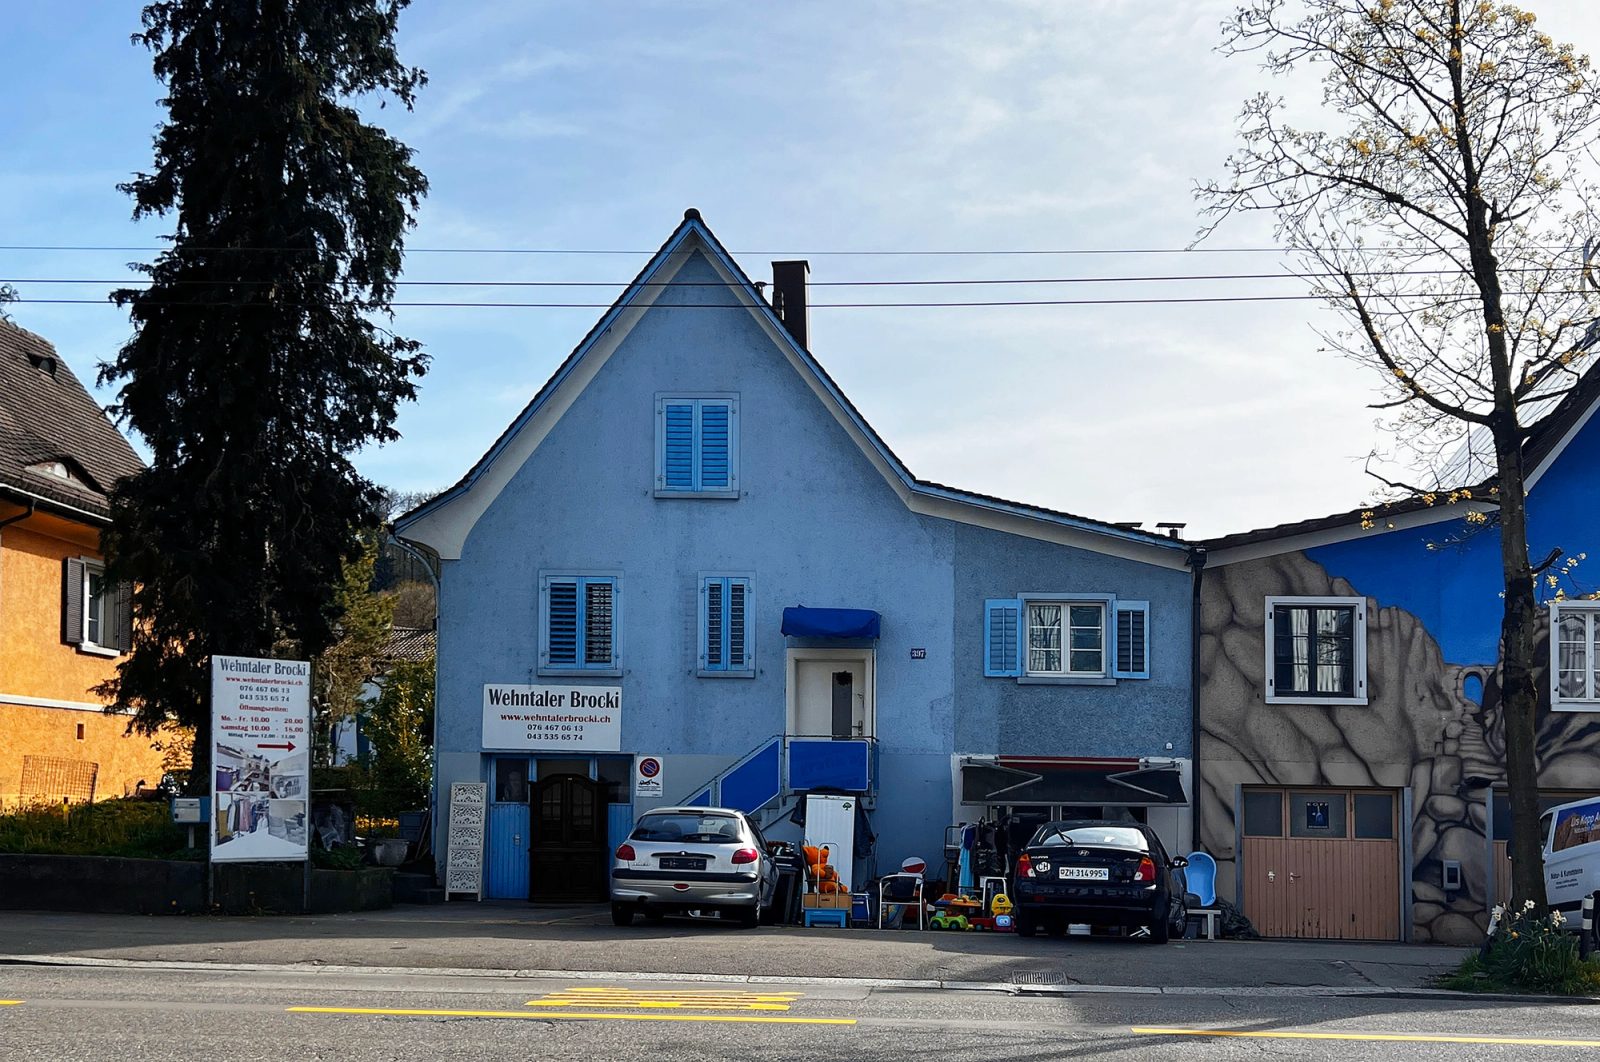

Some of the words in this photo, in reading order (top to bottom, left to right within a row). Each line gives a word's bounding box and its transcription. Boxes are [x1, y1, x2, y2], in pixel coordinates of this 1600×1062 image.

[221, 658, 271, 674] Wehntaler
[275, 663, 306, 676] Brocki
[489, 688, 565, 708] Wehntaler
[570, 690, 619, 709] Brocki
[500, 713, 611, 723] www.wehntalerbrocki.ch
[1038, 862, 1050, 871] CH
